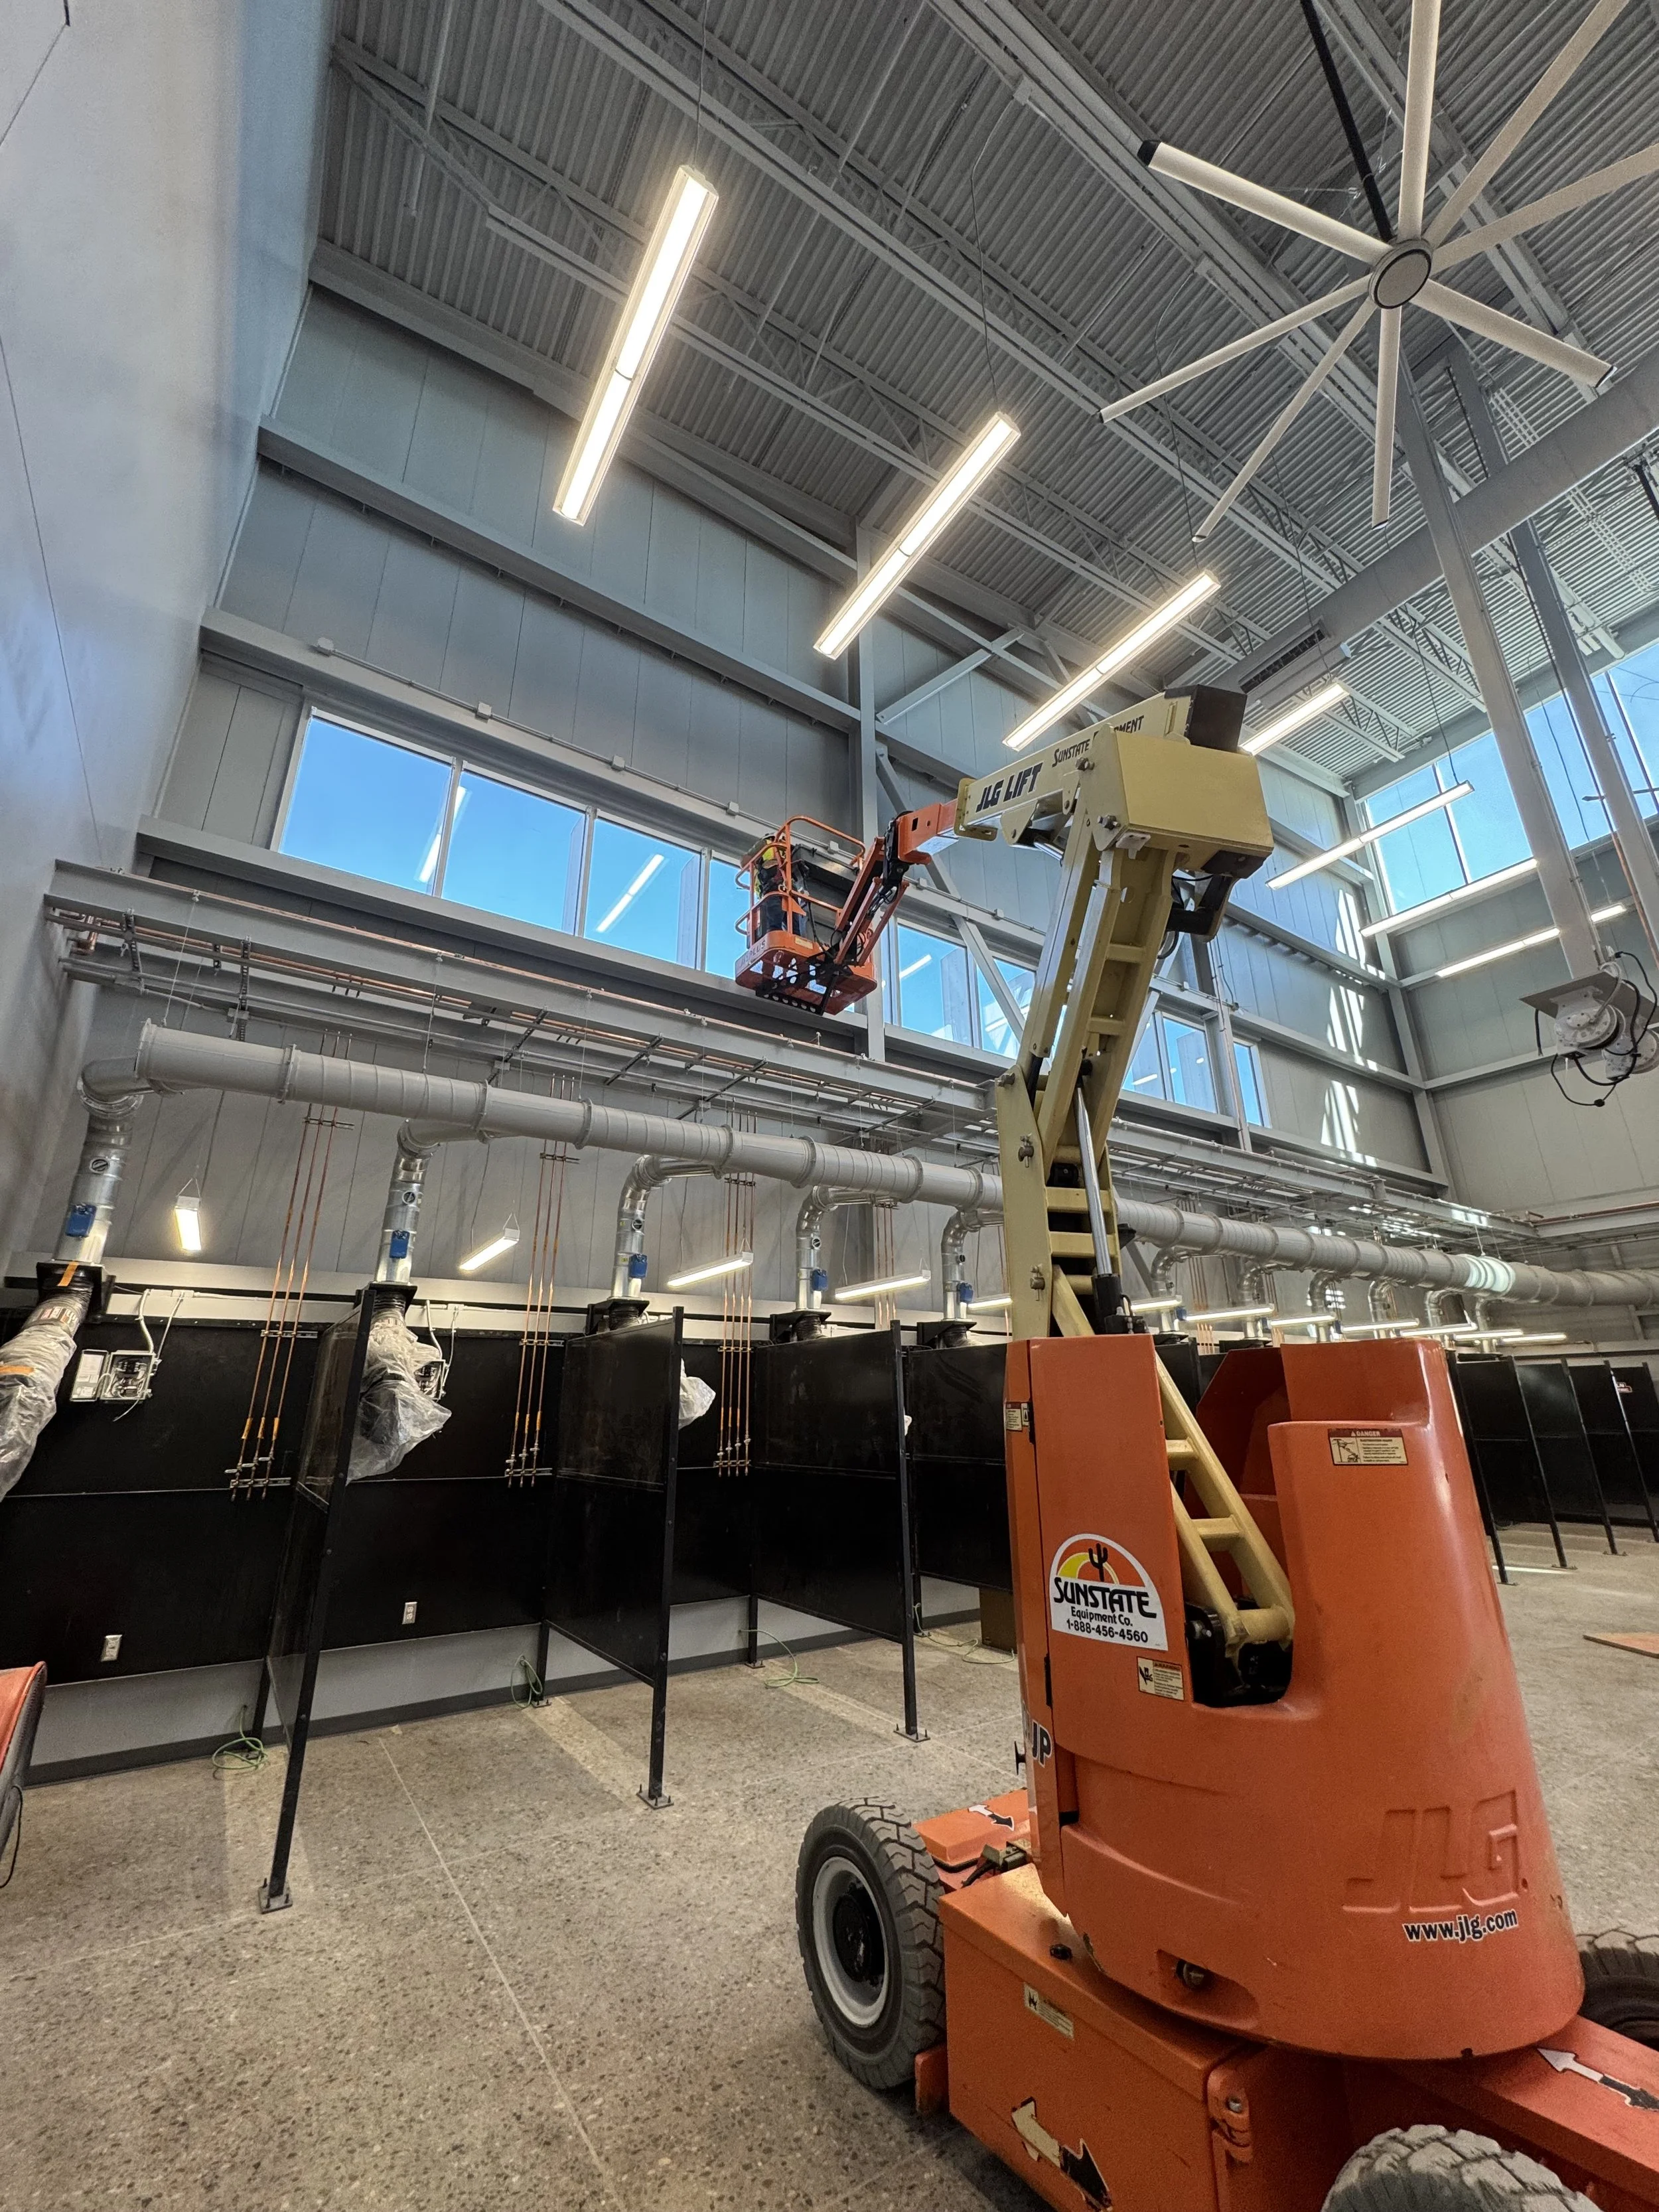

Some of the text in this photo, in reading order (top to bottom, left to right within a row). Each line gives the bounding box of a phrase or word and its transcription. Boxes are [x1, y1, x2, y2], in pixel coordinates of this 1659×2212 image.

[975, 763, 1043, 813] JLG LIFT
[1054, 1577, 1157, 1619] SUNSTATE
[1066, 1618, 1149, 1643] 1-888-456-4560
[1071, 1606, 1133, 1627] Equipment Co.
[1404, 1909, 1518, 1943] www.jlg.com
